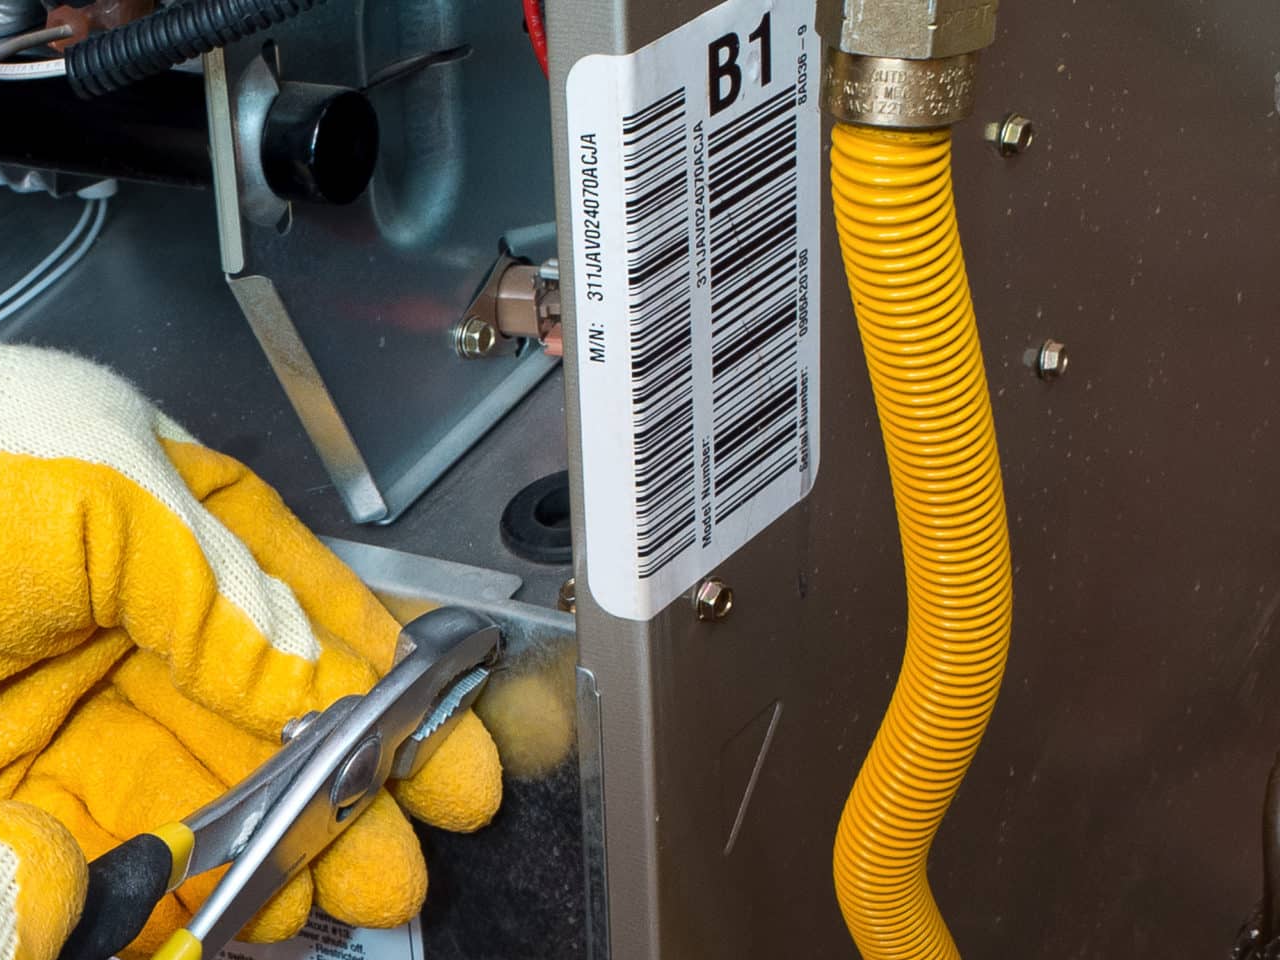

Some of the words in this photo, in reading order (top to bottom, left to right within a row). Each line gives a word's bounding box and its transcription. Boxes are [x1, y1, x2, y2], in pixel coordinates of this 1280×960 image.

[708, 11, 771, 117] B1
[580, 133, 603, 302] 311JAV024070ACJA
[589, 322, 605, 363] M/N:
[701, 435, 711, 501] Number:
[702, 502, 712, 549] Model
